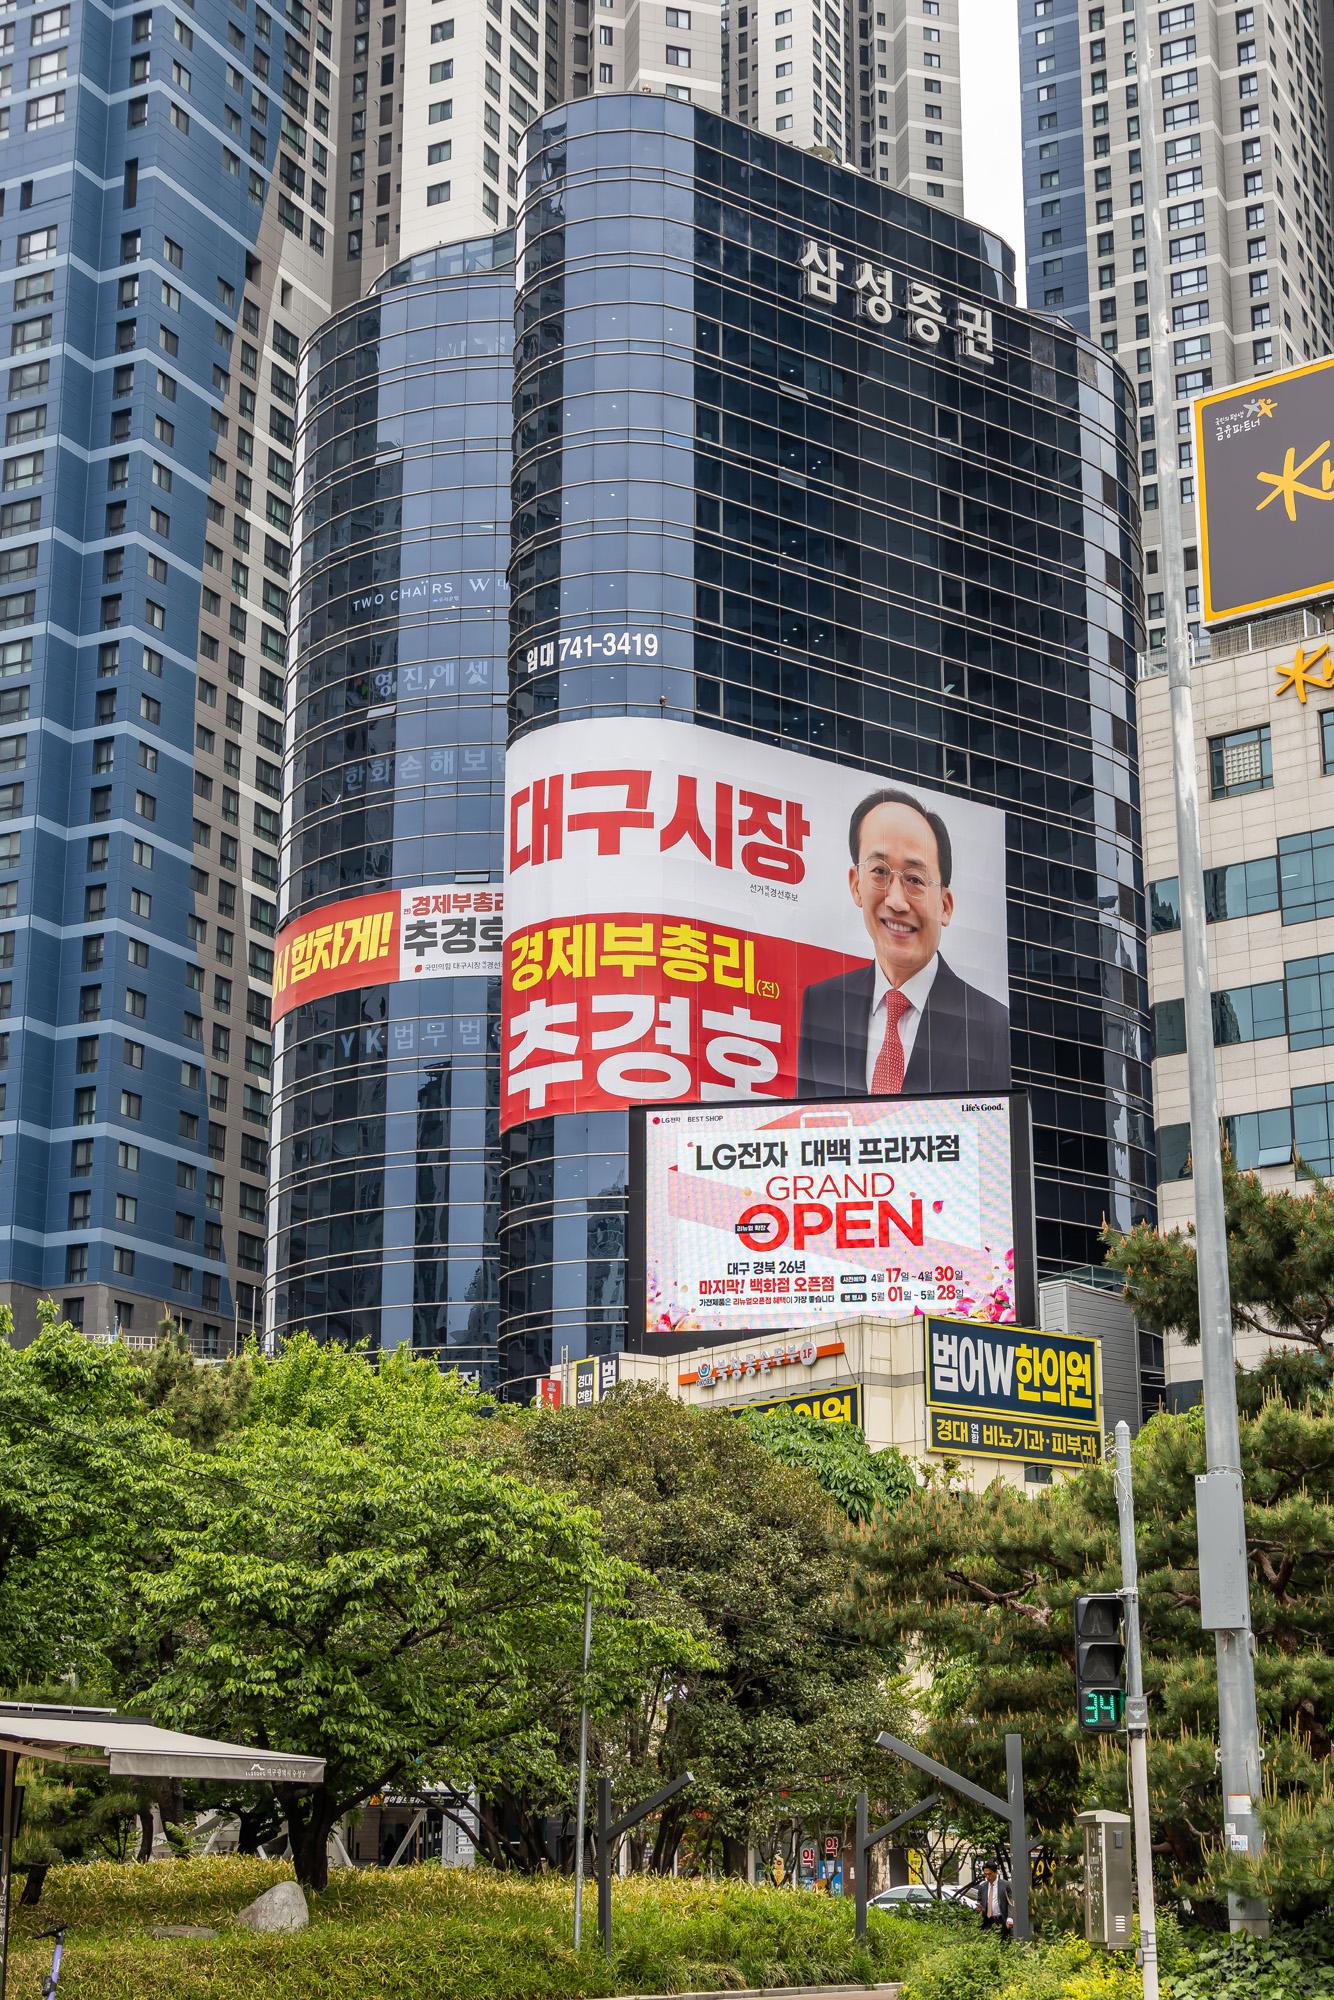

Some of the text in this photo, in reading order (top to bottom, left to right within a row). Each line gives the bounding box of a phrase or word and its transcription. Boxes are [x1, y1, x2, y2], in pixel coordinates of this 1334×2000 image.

[800, 240, 994, 365] 삼성증권
[1215, 418, 1260, 441] 금융파트너
[353, 594, 384, 611] TWO
[527, 632, 658, 673] 임대 741-3419
[375, 661, 488, 697] 영진에셋
[510, 769, 811, 885] 대구시장
[291, 911, 394, 985] 힘차게!
[511, 922, 755, 994] 경제부총리
[424, 963, 452, 971] 국민의힘
[452, 962, 481, 970] 대구시장
[507, 993, 782, 1110] 추경호
[961, 1103, 1004, 1112] Life's Good.
[696, 1134, 960, 1171] LG전자 대백 프라자점
[766, 1172, 895, 1201] GRAND
[738, 1199, 924, 1252] OPEN
[727, 1260, 806, 1275] 대구 경북 26년
[871, 1273, 885, 1282] 4월
[886, 1267, 909, 1282] 17일
[917, 1271, 933, 1282] 4월
[935, 1266, 963, 1281] 30일
[699, 1276, 835, 1295] 마지막! 백화점 오픈점
[871, 1292, 885, 1301] 5월
[888, 1286, 912, 1302] 01일
[920, 1289, 935, 1301] 5월
[936, 1285, 964, 1300] 28일
[699, 1298, 731, 1307] 가전제품은
[733, 1296, 772, 1305] 리뉴얼오픈점
[794, 1295, 807, 1304] 가장
[808, 1294, 835, 1304] 좋습니다
[716, 1345, 812, 1382] 북창동순두부 1F
[577, 1372, 593, 1388] 경대
[577, 1389, 593, 1404] 연합
[936, 1418, 969, 1443] 경대
[1085, 1692, 1115, 1724] 34
[802, 1848, 814, 1868] 약
[825, 1836, 839, 1857] 약
